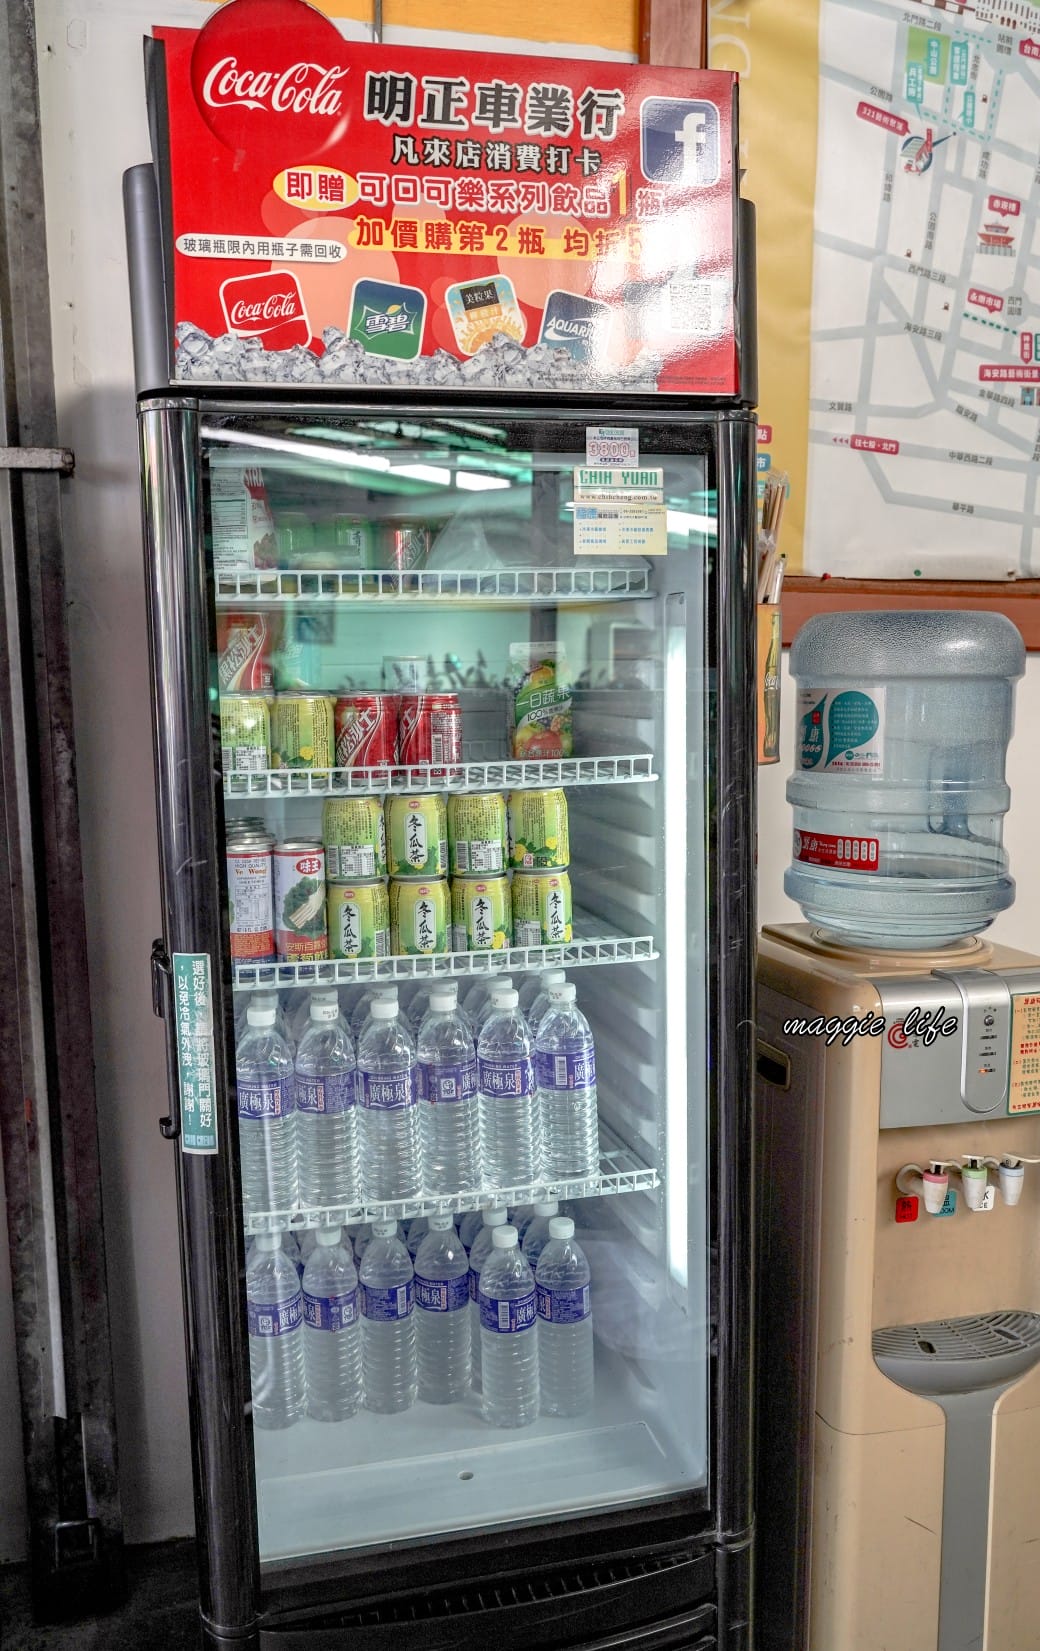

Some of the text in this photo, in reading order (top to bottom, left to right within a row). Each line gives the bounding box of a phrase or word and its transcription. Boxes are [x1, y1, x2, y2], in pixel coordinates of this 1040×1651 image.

[1023, 43, 1040, 58] 台南
[202, 57, 350, 115] Coca-Cola
[364, 71, 625, 141] 明正車業行
[392, 134, 602, 176] 凡來店消費打卡
[286, 171, 345, 203] 即贈
[183, 238, 342, 259] 玻璃瓶限內用瓶子需回收
[230, 290, 297, 325] Coca-Cola
[365, 313, 409, 333] 雪碧
[546, 316, 598, 338] AQUARI
[580, 470, 658, 486] CHIH YUAN
[407, 814, 424, 863] 冬瓜茶
[300, 858, 320, 873] 味王
[343, 904, 358, 954] 冬瓜茶
[418, 901, 434, 950] 冬瓜茶
[474, 898, 491, 946] 冬瓜茶
[549, 892, 564, 940] 冬瓜茶
